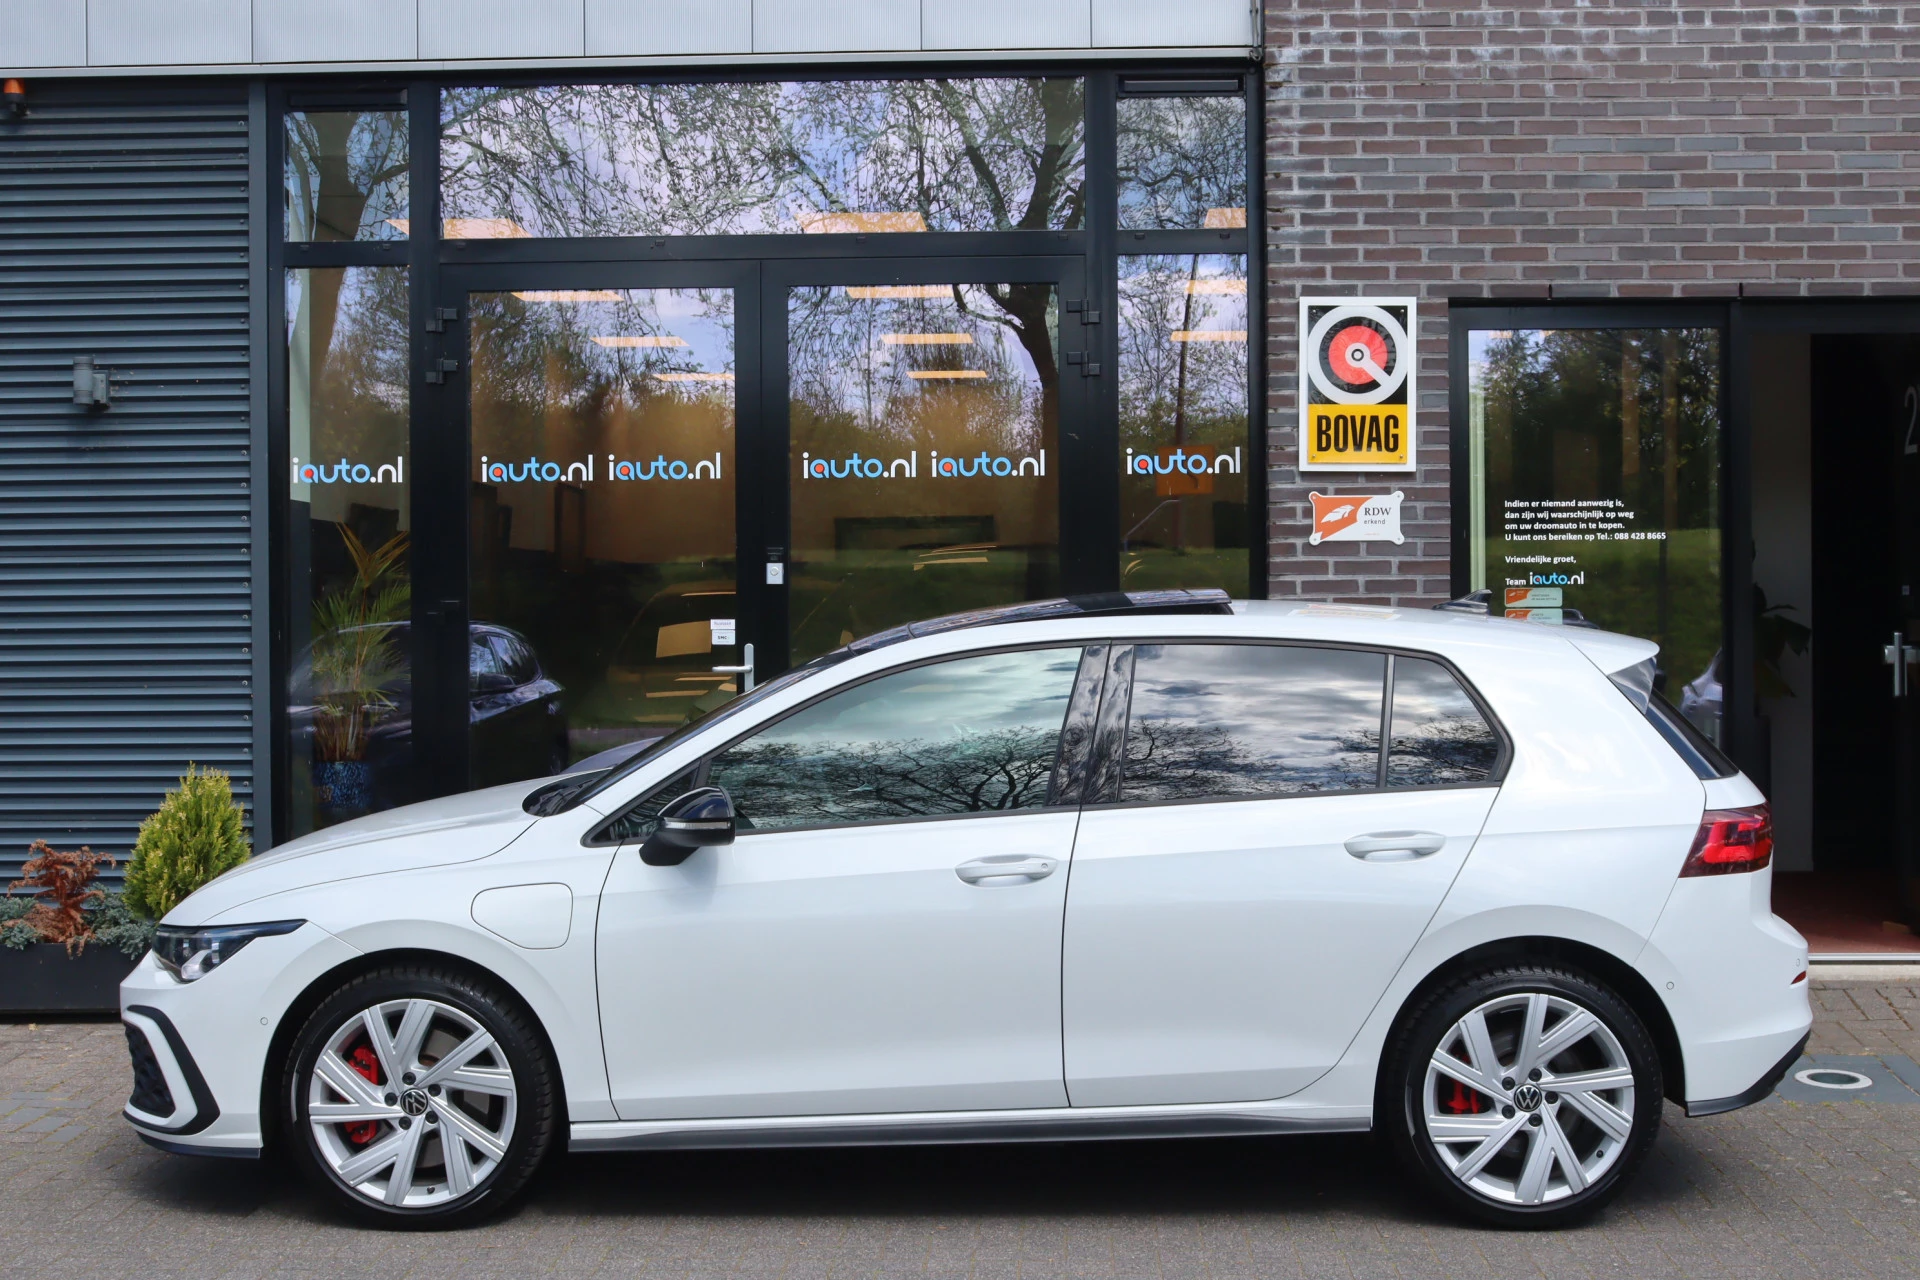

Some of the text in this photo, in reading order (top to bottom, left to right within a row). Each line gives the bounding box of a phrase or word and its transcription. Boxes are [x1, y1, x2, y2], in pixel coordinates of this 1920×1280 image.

[1316, 414, 1399, 453] BOVAG
[802, 449, 1046, 479] iauto.nl iauto.nl
[1126, 446, 1241, 475] iauto.nl
[292, 456, 404, 484] iauto.nl
[480, 452, 721, 483] iauto.nl iauto.nl
[1505, 500, 1529, 508] Indien
[1577, 500, 1614, 508] aanwezig
[1615, 499, 1625, 508] is,
[1364, 507, 1391, 516] RDW
[1505, 511, 1520, 519] dan
[1521, 511, 1535, 520] zijn
[1537, 511, 1549, 520] wij
[1551, 511, 1604, 520] waarschijnlijk
[1534, 522, 1578, 530] droomauto
[1599, 522, 1625, 530] kopen.
[1549, 533, 1583, 541] bereiken
[1584, 534, 1595, 542] op
[1505, 556, 1577, 564] Vriendelijke groet,
[1505, 571, 1585, 586] Team iauto.nl
